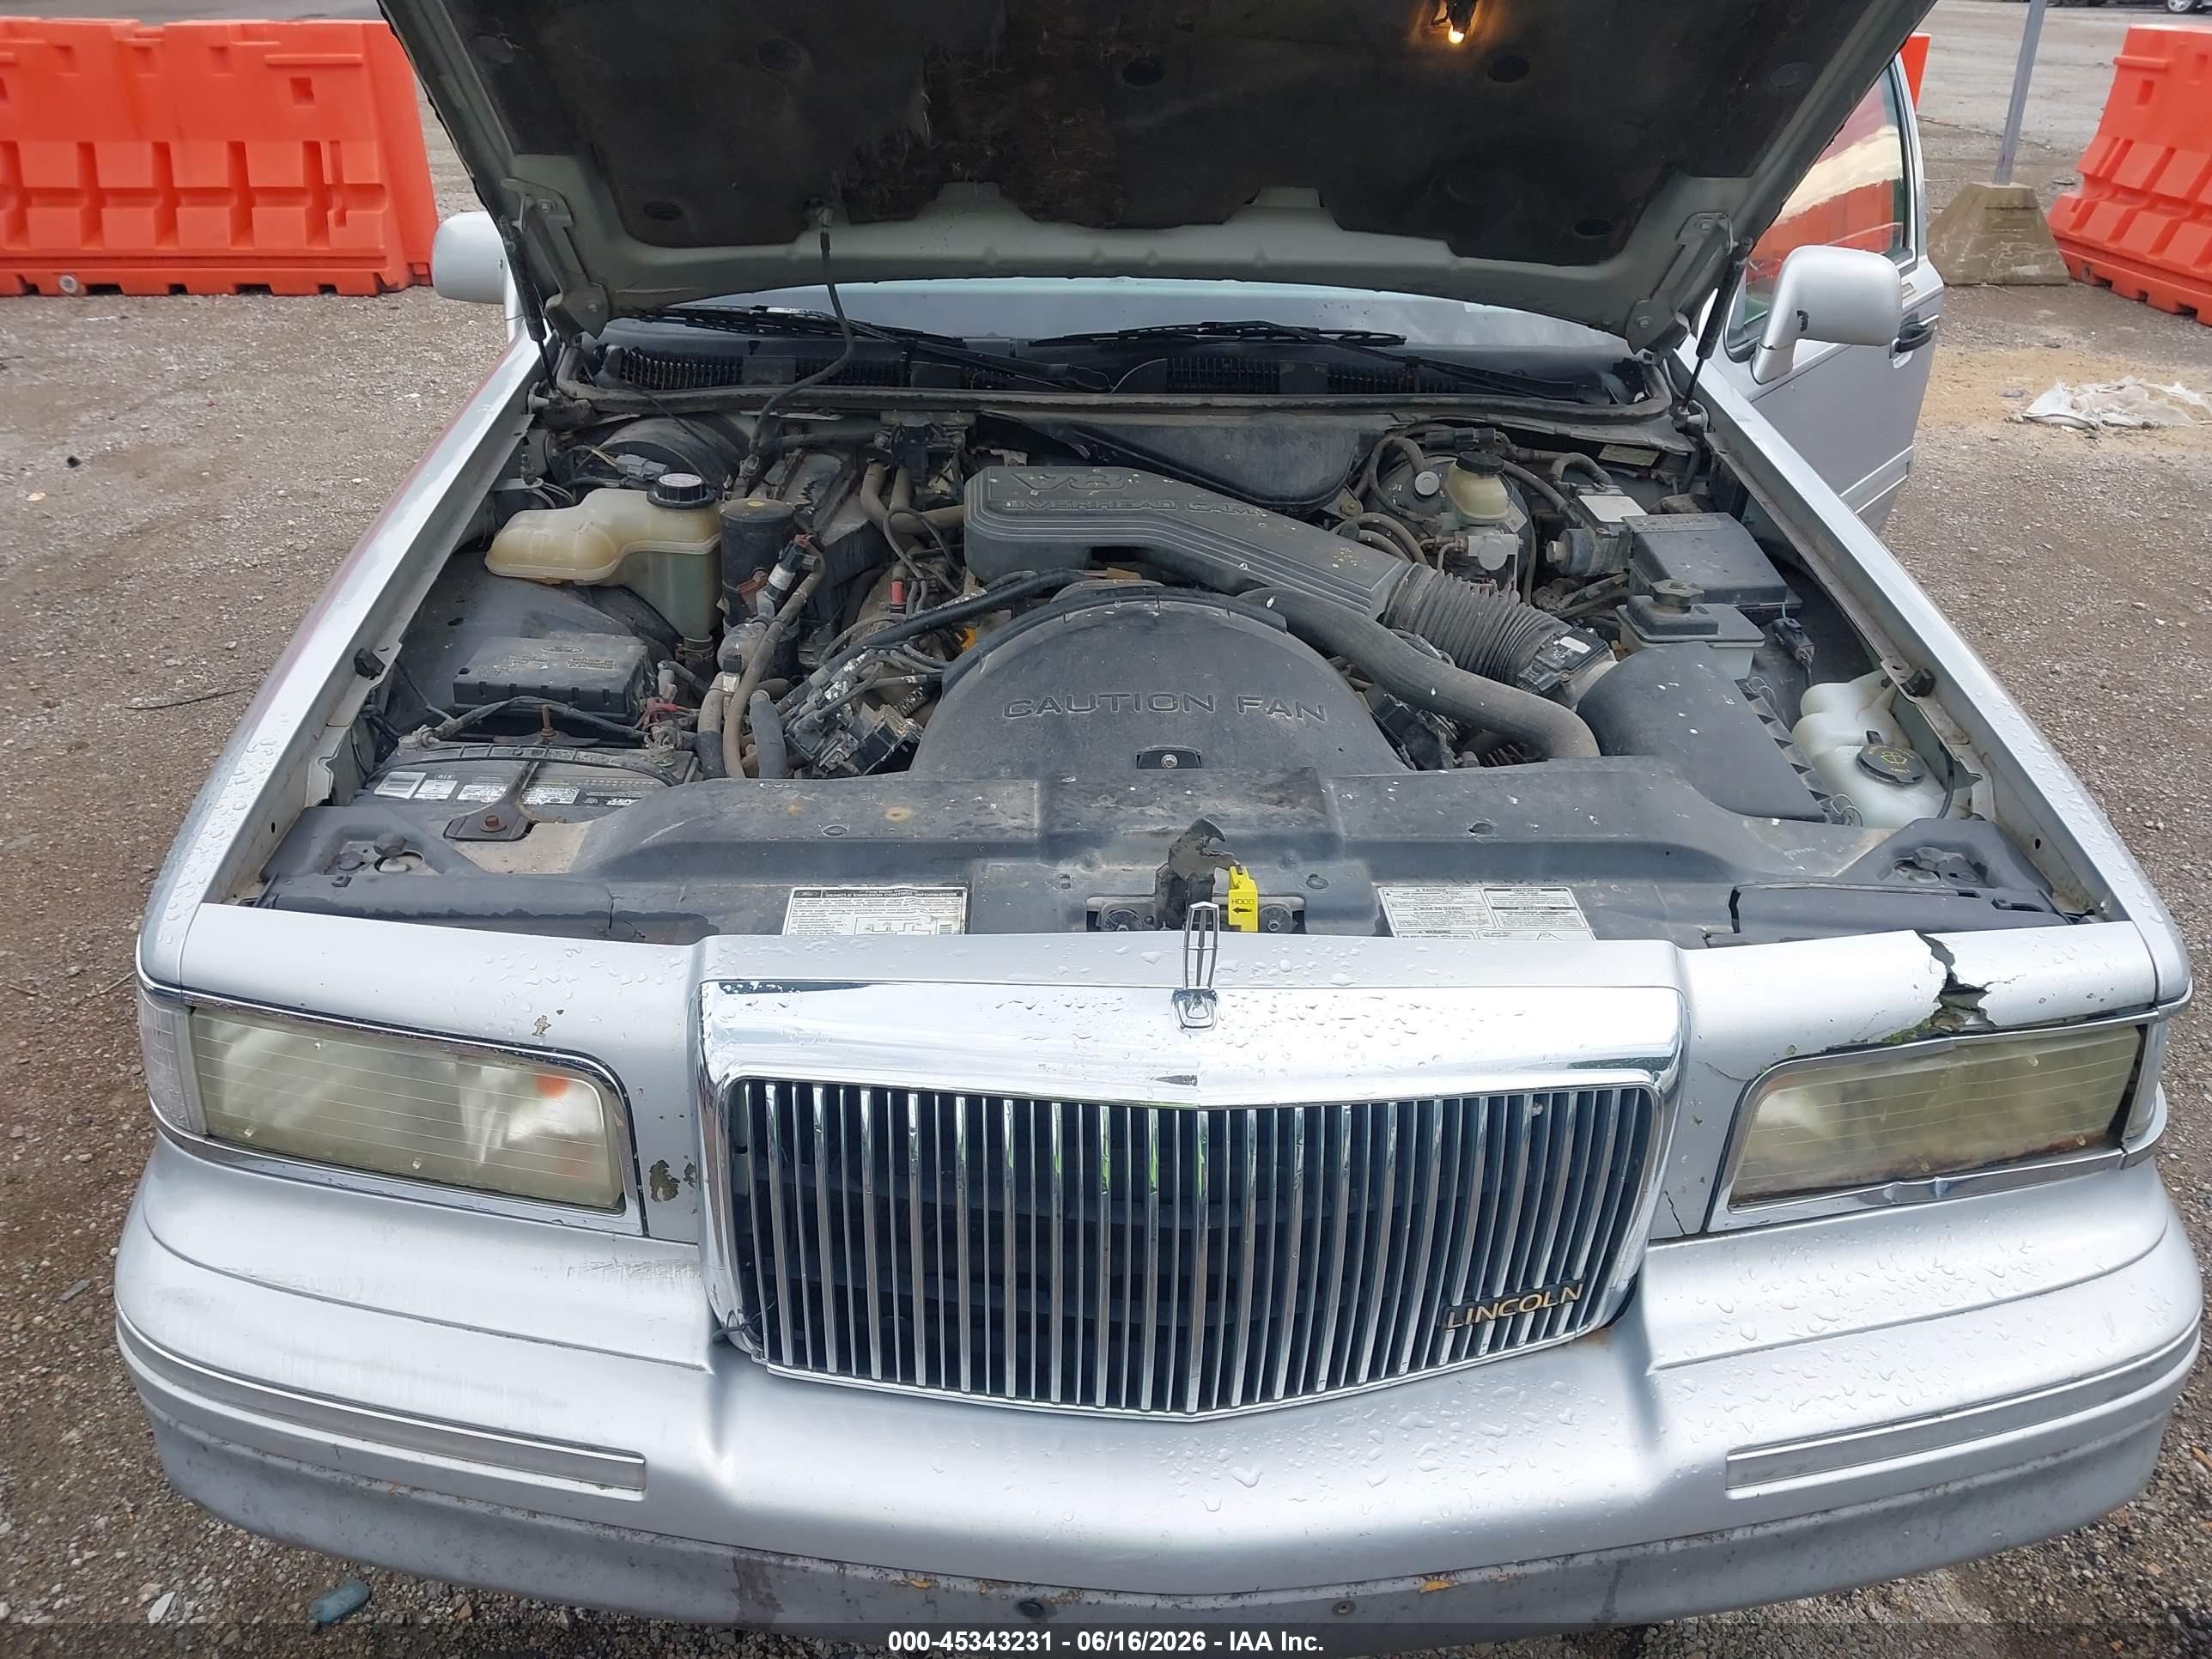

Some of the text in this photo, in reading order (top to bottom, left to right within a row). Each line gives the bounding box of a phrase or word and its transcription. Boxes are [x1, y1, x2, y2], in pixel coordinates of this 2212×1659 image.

[1011, 473, 1127, 491] V8
[1004, 500, 1177, 511] OVERHEAD
[1002, 692, 1328, 724] CAUTION FAN
[1447, 1283, 1583, 1329] LINCOLN
